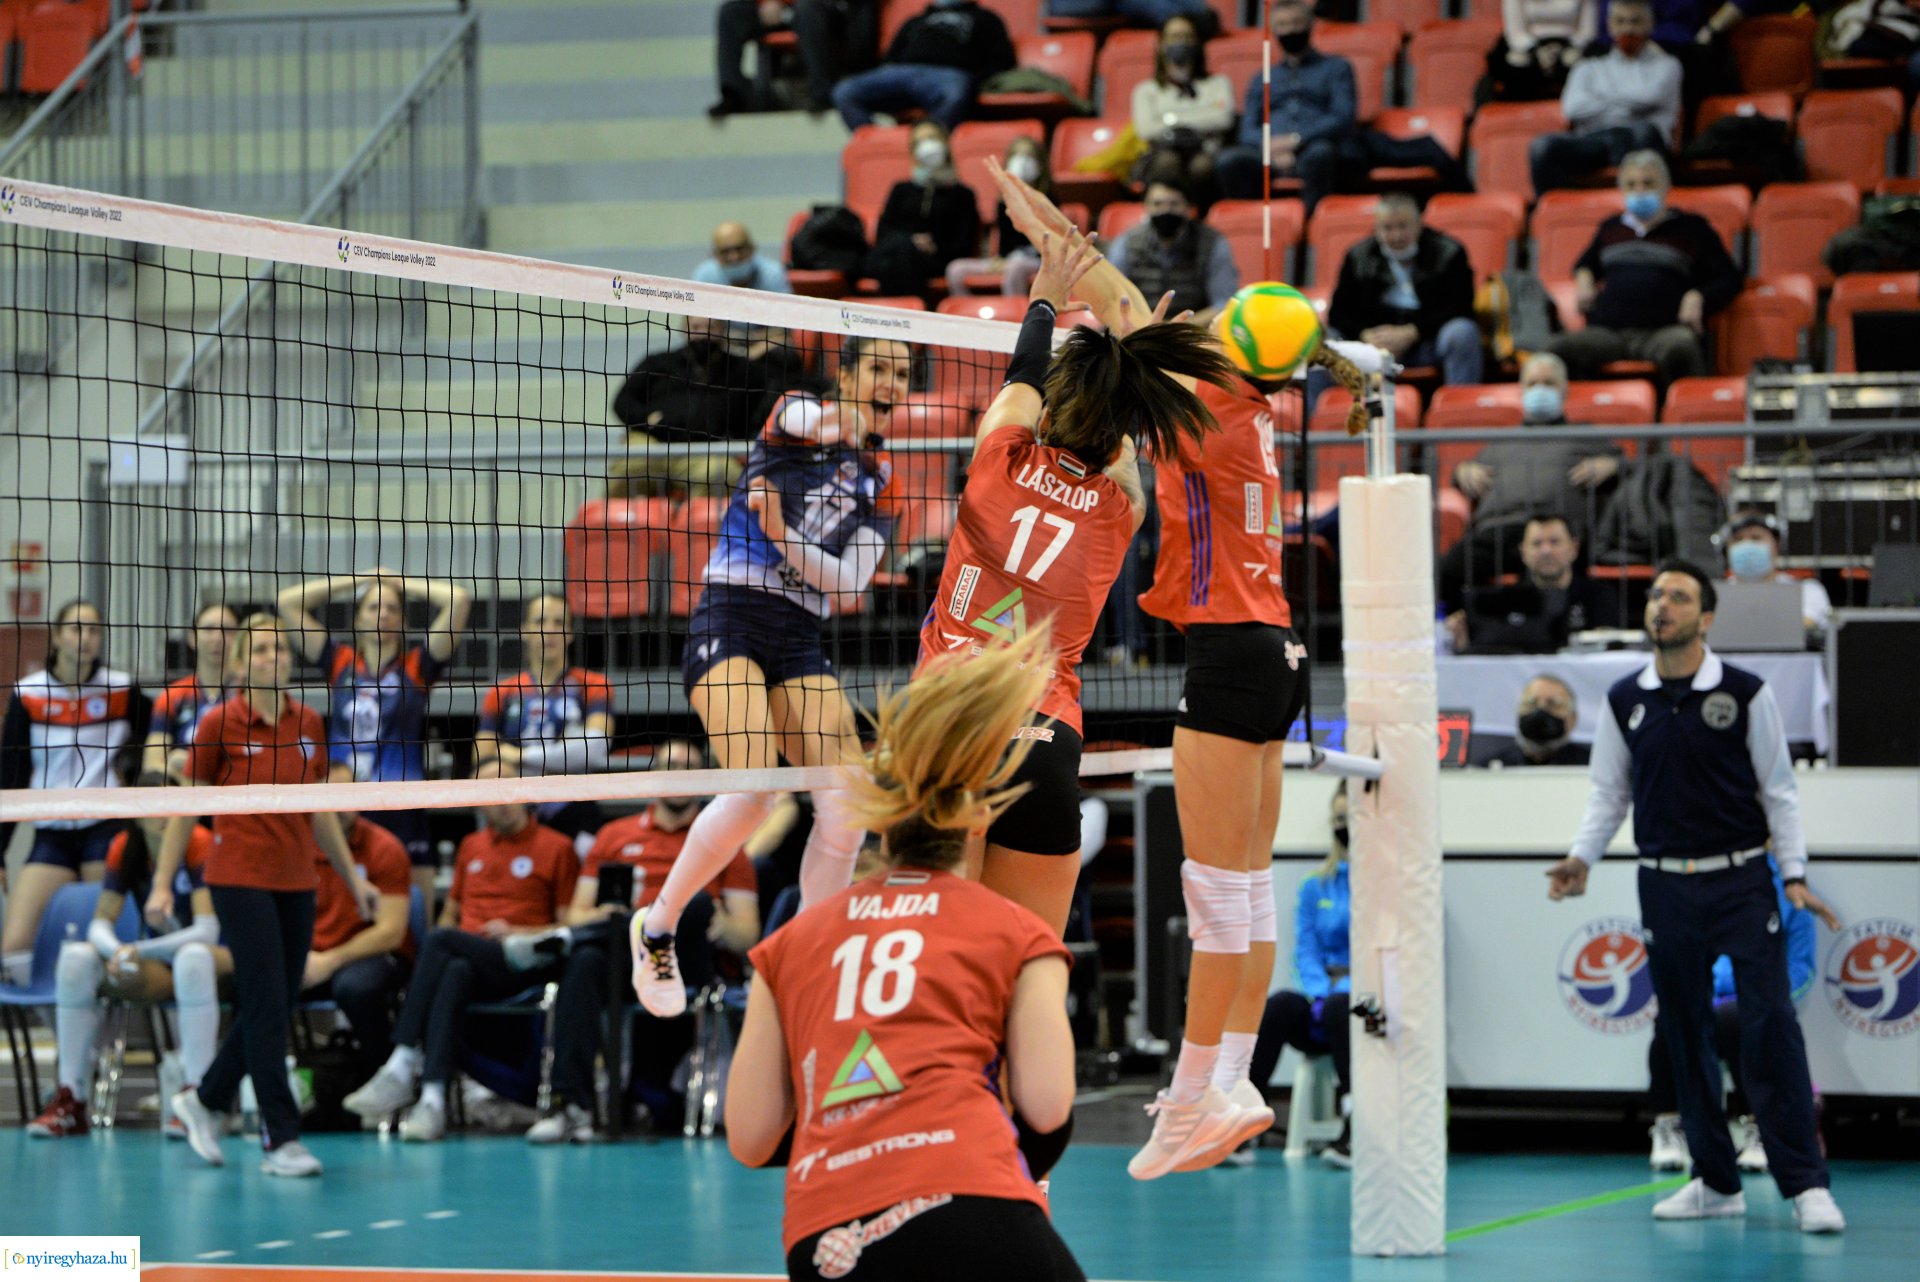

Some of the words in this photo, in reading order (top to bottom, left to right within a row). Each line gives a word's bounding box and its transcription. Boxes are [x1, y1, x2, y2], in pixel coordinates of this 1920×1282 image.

[20, 195, 33, 208] CEV
[34, 198, 67, 214] Champions
[68, 203, 89, 218] League
[90, 206, 109, 222] Volley
[109, 209, 122, 221] 2022
[353, 245, 364, 256] CEV
[363, 247, 391, 261] Champions
[391, 251, 410, 264] League
[409, 253, 425, 267] Volley
[425, 255, 436, 266] 2022
[626, 284, 634, 293] CEV
[635, 285, 657, 297] Champions
[656, 288, 673, 300] League
[672, 290, 685, 302] Volley
[1015, 464, 1099, 513] LÁSZLOP
[1003, 504, 1076, 583] 17
[953, 568, 974, 617] STRABAG
[847, 892, 940, 921] VAJDA
[831, 929, 924, 1022] 18
